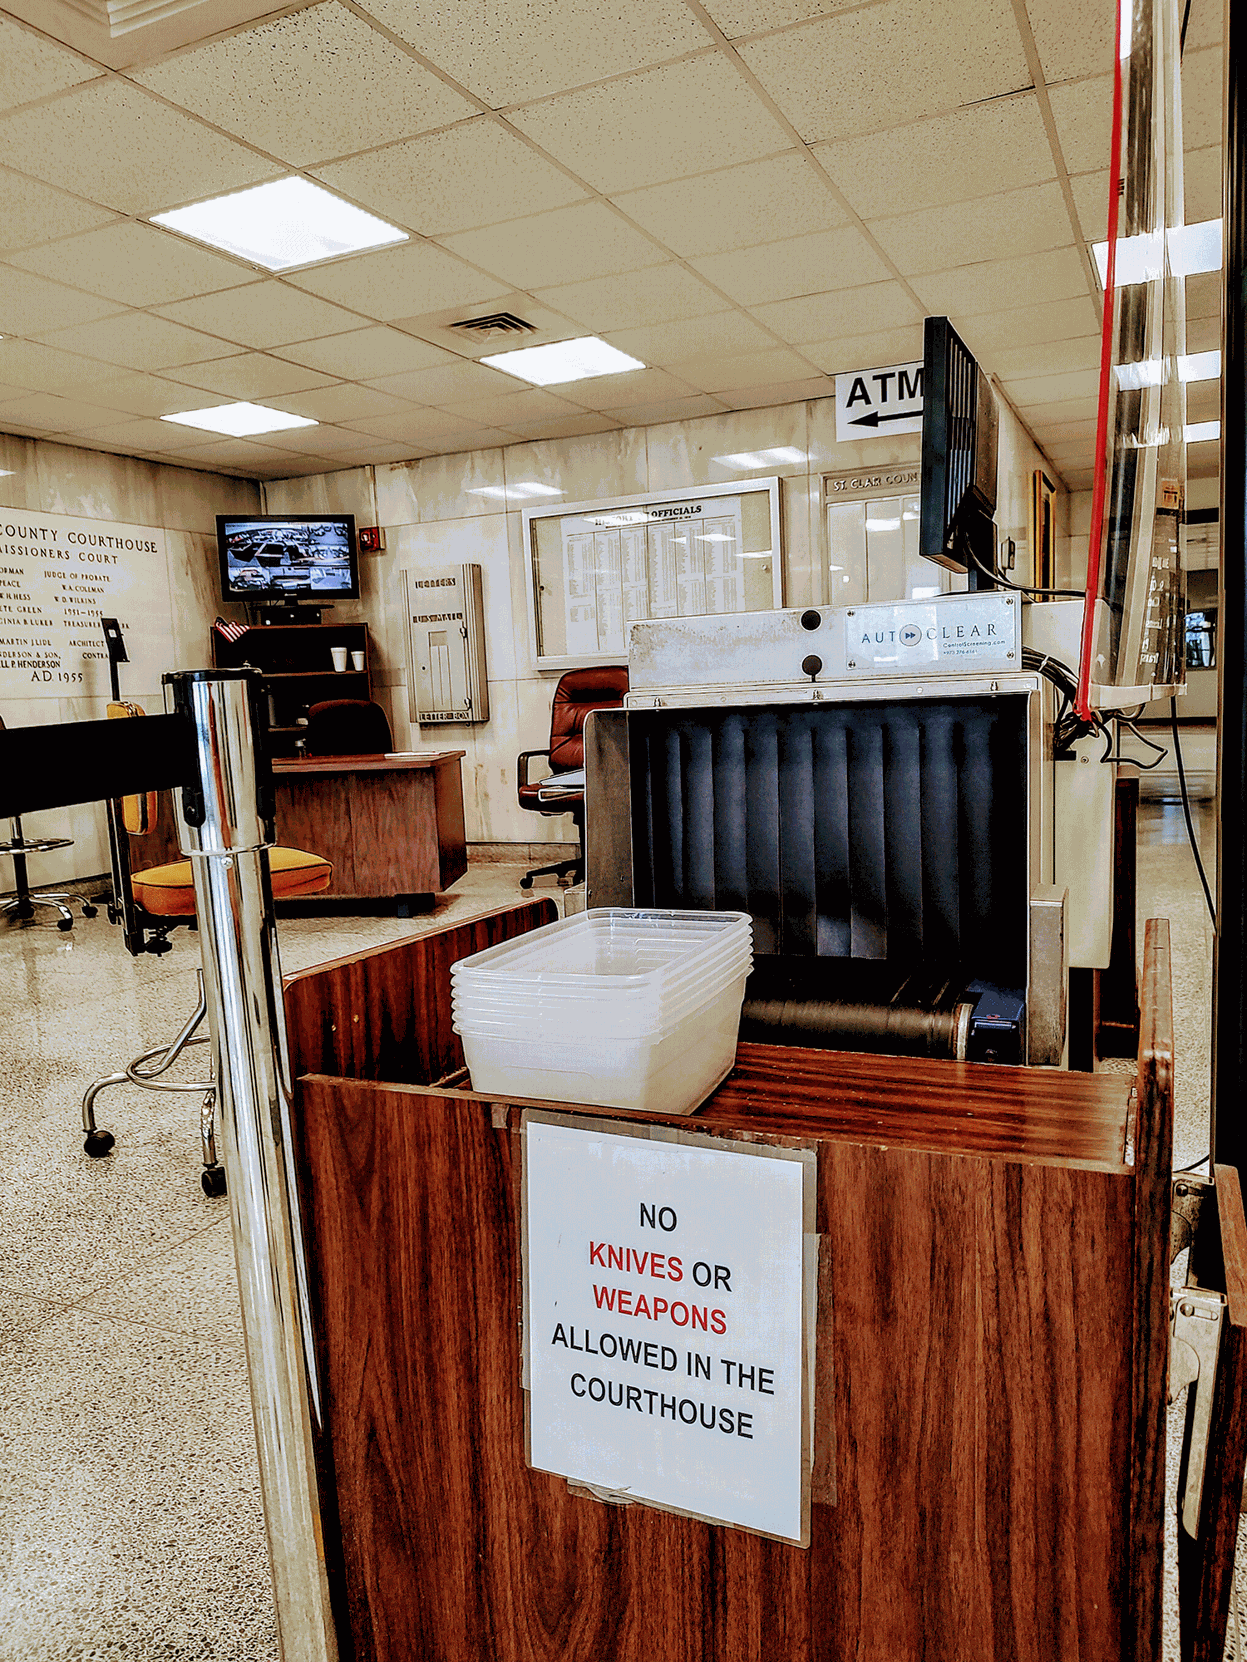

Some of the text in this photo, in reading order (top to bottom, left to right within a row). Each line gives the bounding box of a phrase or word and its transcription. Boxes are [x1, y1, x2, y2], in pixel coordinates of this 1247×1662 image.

[845, 367, 925, 409] ATM
[651, 505, 702, 517] OFFICIALS
[67, 531, 158, 553] COURTHOUSE
[78, 551, 118, 564] COURT
[44, 570, 66, 579] JUDGE
[17, 660, 61, 669] HENDERSON
[58, 672, 83, 683] 1955
[640, 1202, 677, 1232] NO
[589, 1241, 732, 1292] KNIVES OR
[592, 1284, 727, 1335] WEAPONS
[551, 1322, 775, 1395] ALLOWED IN THE
[570, 1373, 754, 1440] COURTHOUSE
